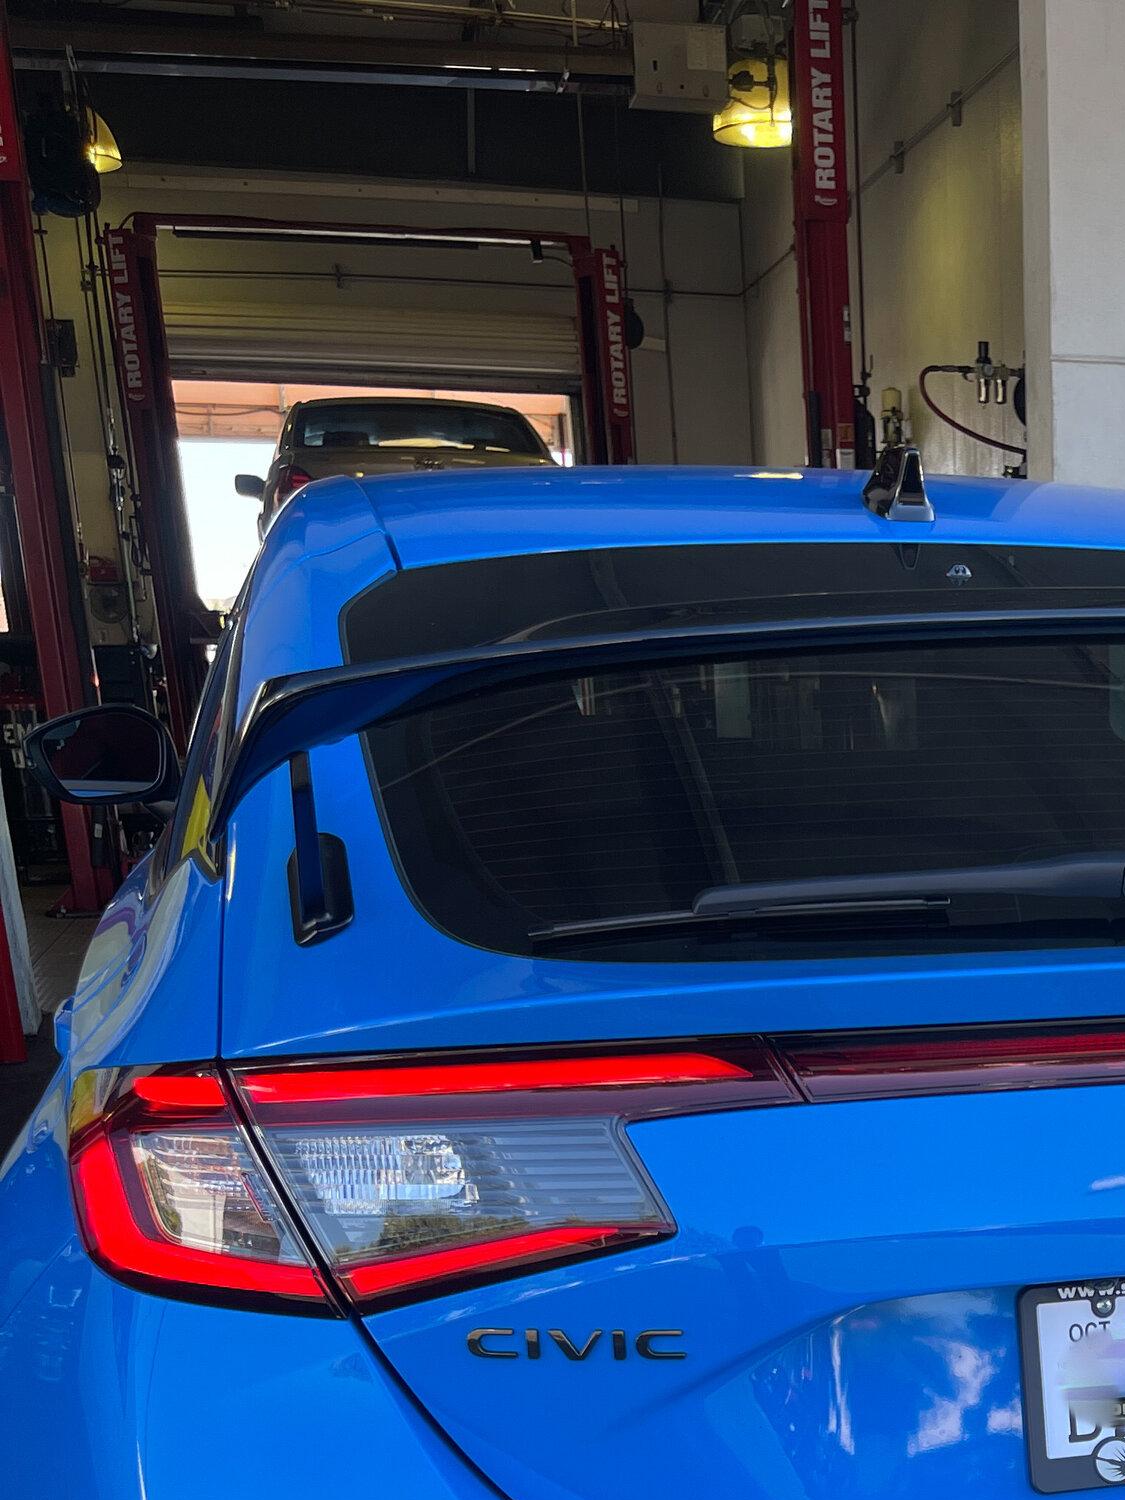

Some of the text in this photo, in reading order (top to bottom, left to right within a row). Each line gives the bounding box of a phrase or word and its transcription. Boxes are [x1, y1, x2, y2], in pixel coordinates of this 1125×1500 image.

[807, 0, 836, 190] ROTARY LIFT
[108, 234, 143, 389] ROTARY LIFT
[602, 253, 627, 405] ROTARY LIFT
[467, 1328, 687, 1360] CIVIC
